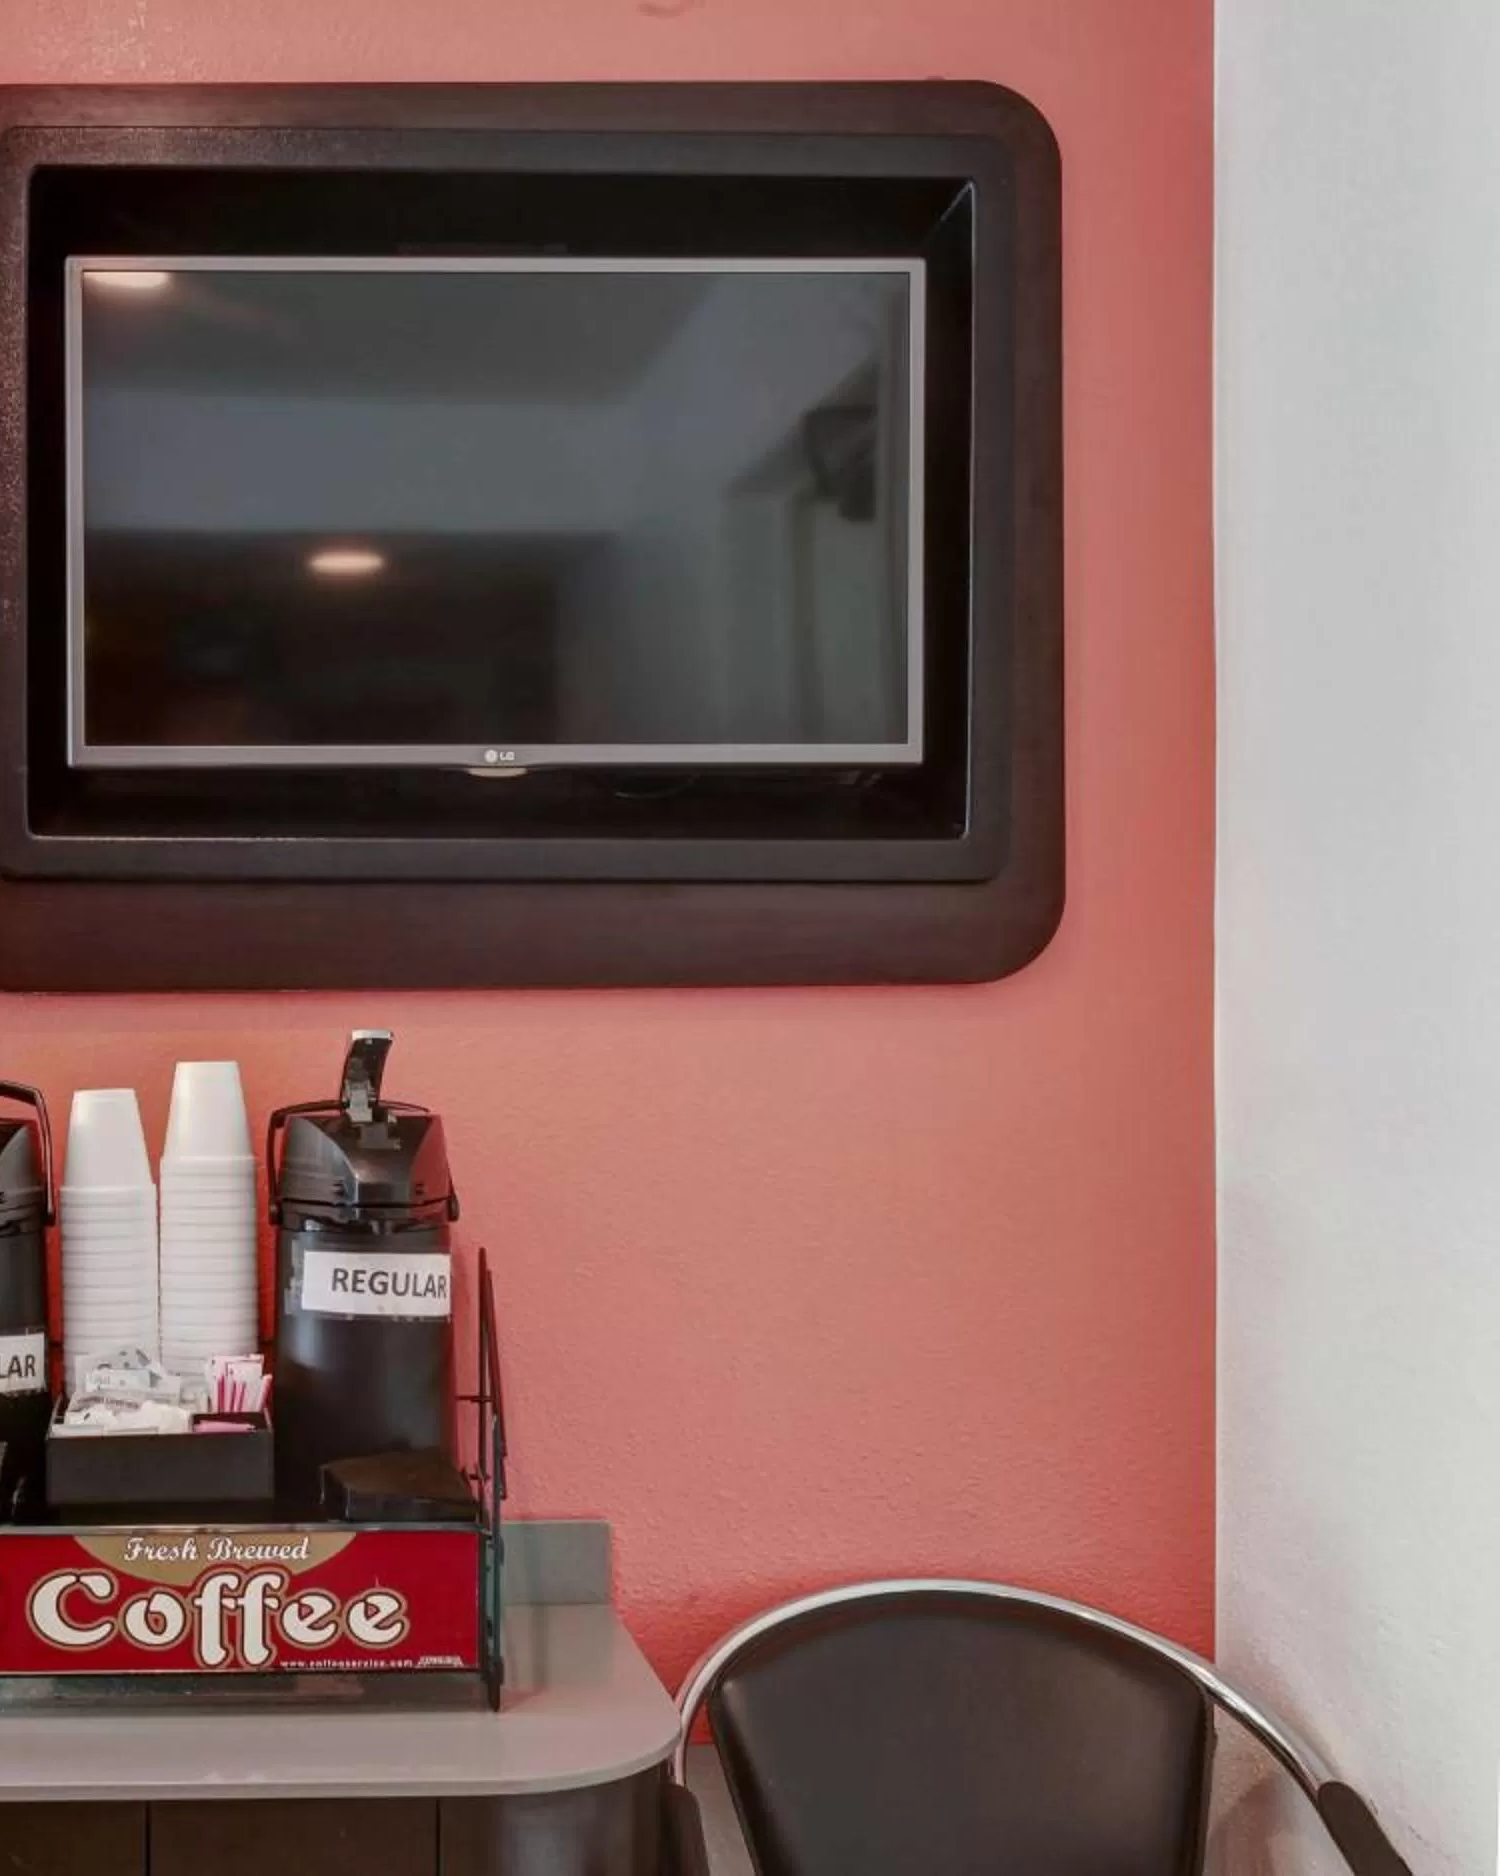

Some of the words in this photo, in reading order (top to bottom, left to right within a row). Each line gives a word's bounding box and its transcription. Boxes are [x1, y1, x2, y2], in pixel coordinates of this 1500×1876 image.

[499, 751, 515, 760] LG
[331, 1267, 448, 1299] REGULAR
[124, 1536, 199, 1561] Fresh
[207, 1536, 309, 1561] Brewed
[28, 1571, 407, 1667] Coffee
